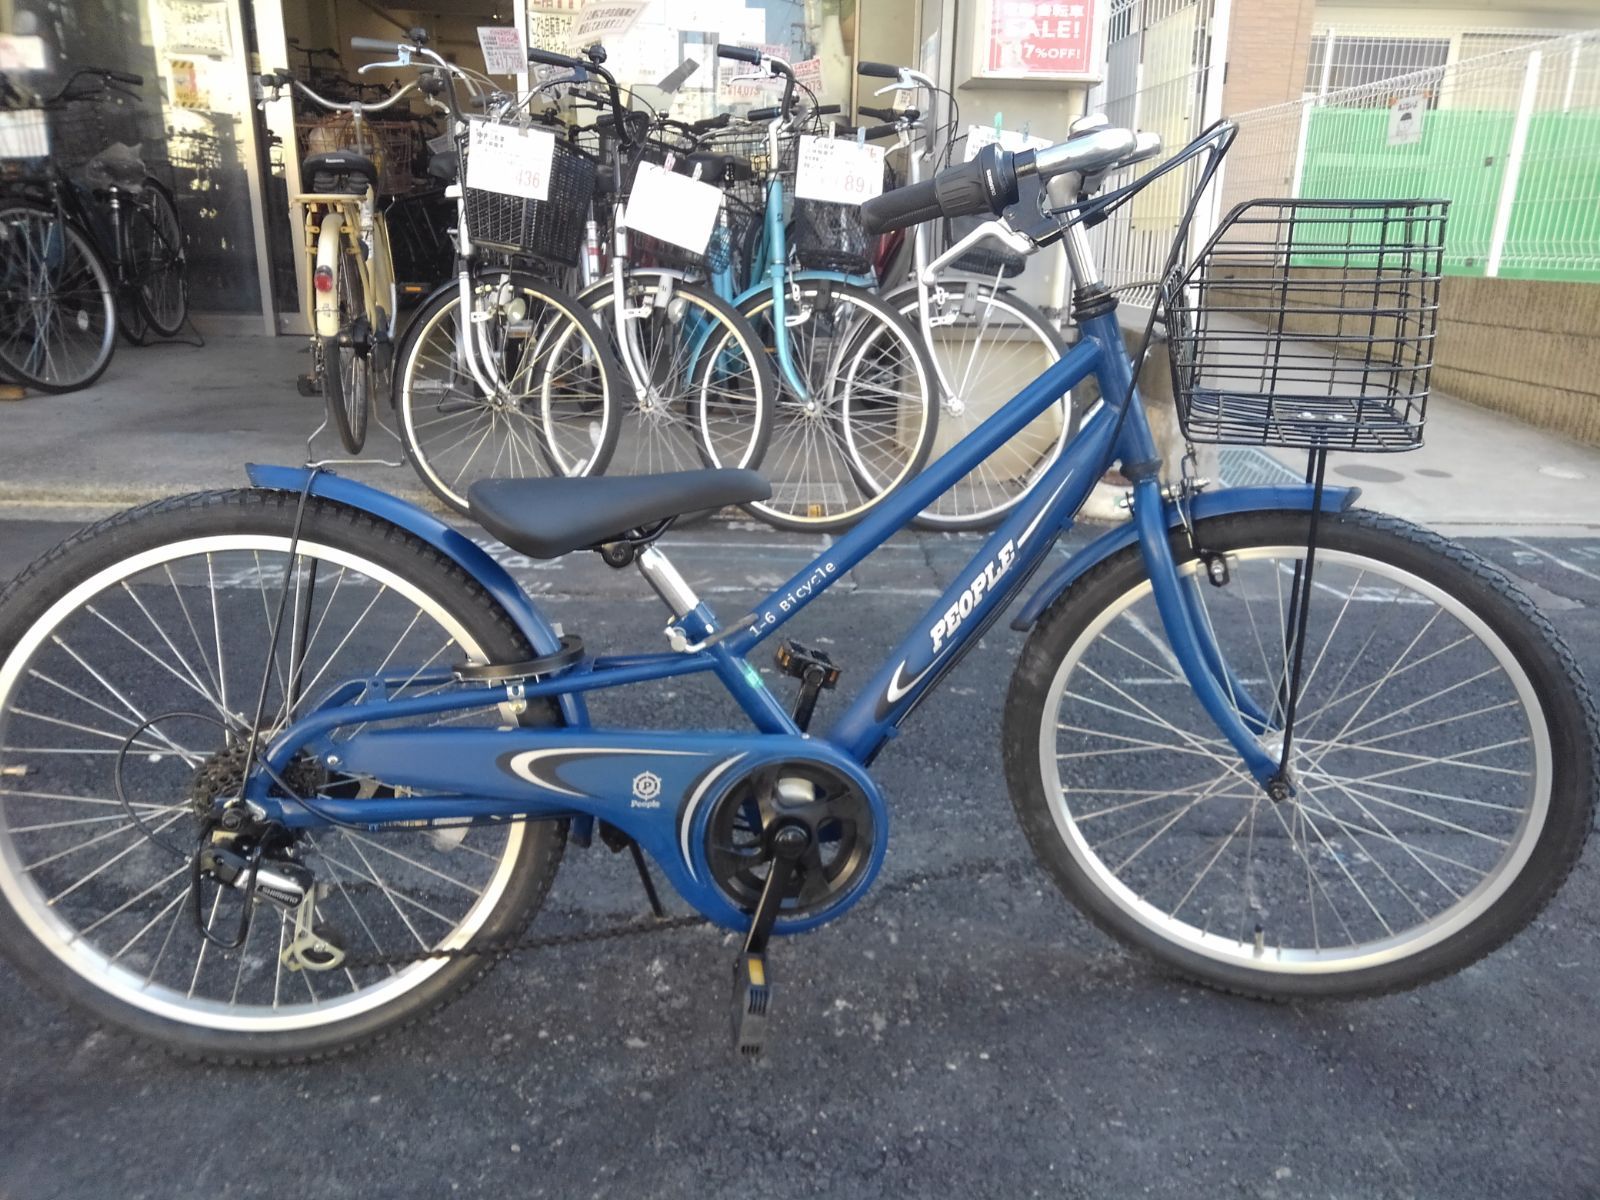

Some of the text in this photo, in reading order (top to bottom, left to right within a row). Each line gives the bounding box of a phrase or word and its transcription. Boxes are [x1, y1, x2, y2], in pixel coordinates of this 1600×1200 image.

[1005, 20, 1081, 39] ALE!
[749, 562, 837, 637] 1-6 Bicycle
[930, 539, 1015, 654] PEOPLE
[631, 799, 660, 809] People
[262, 886, 298, 904] SHIMANO
